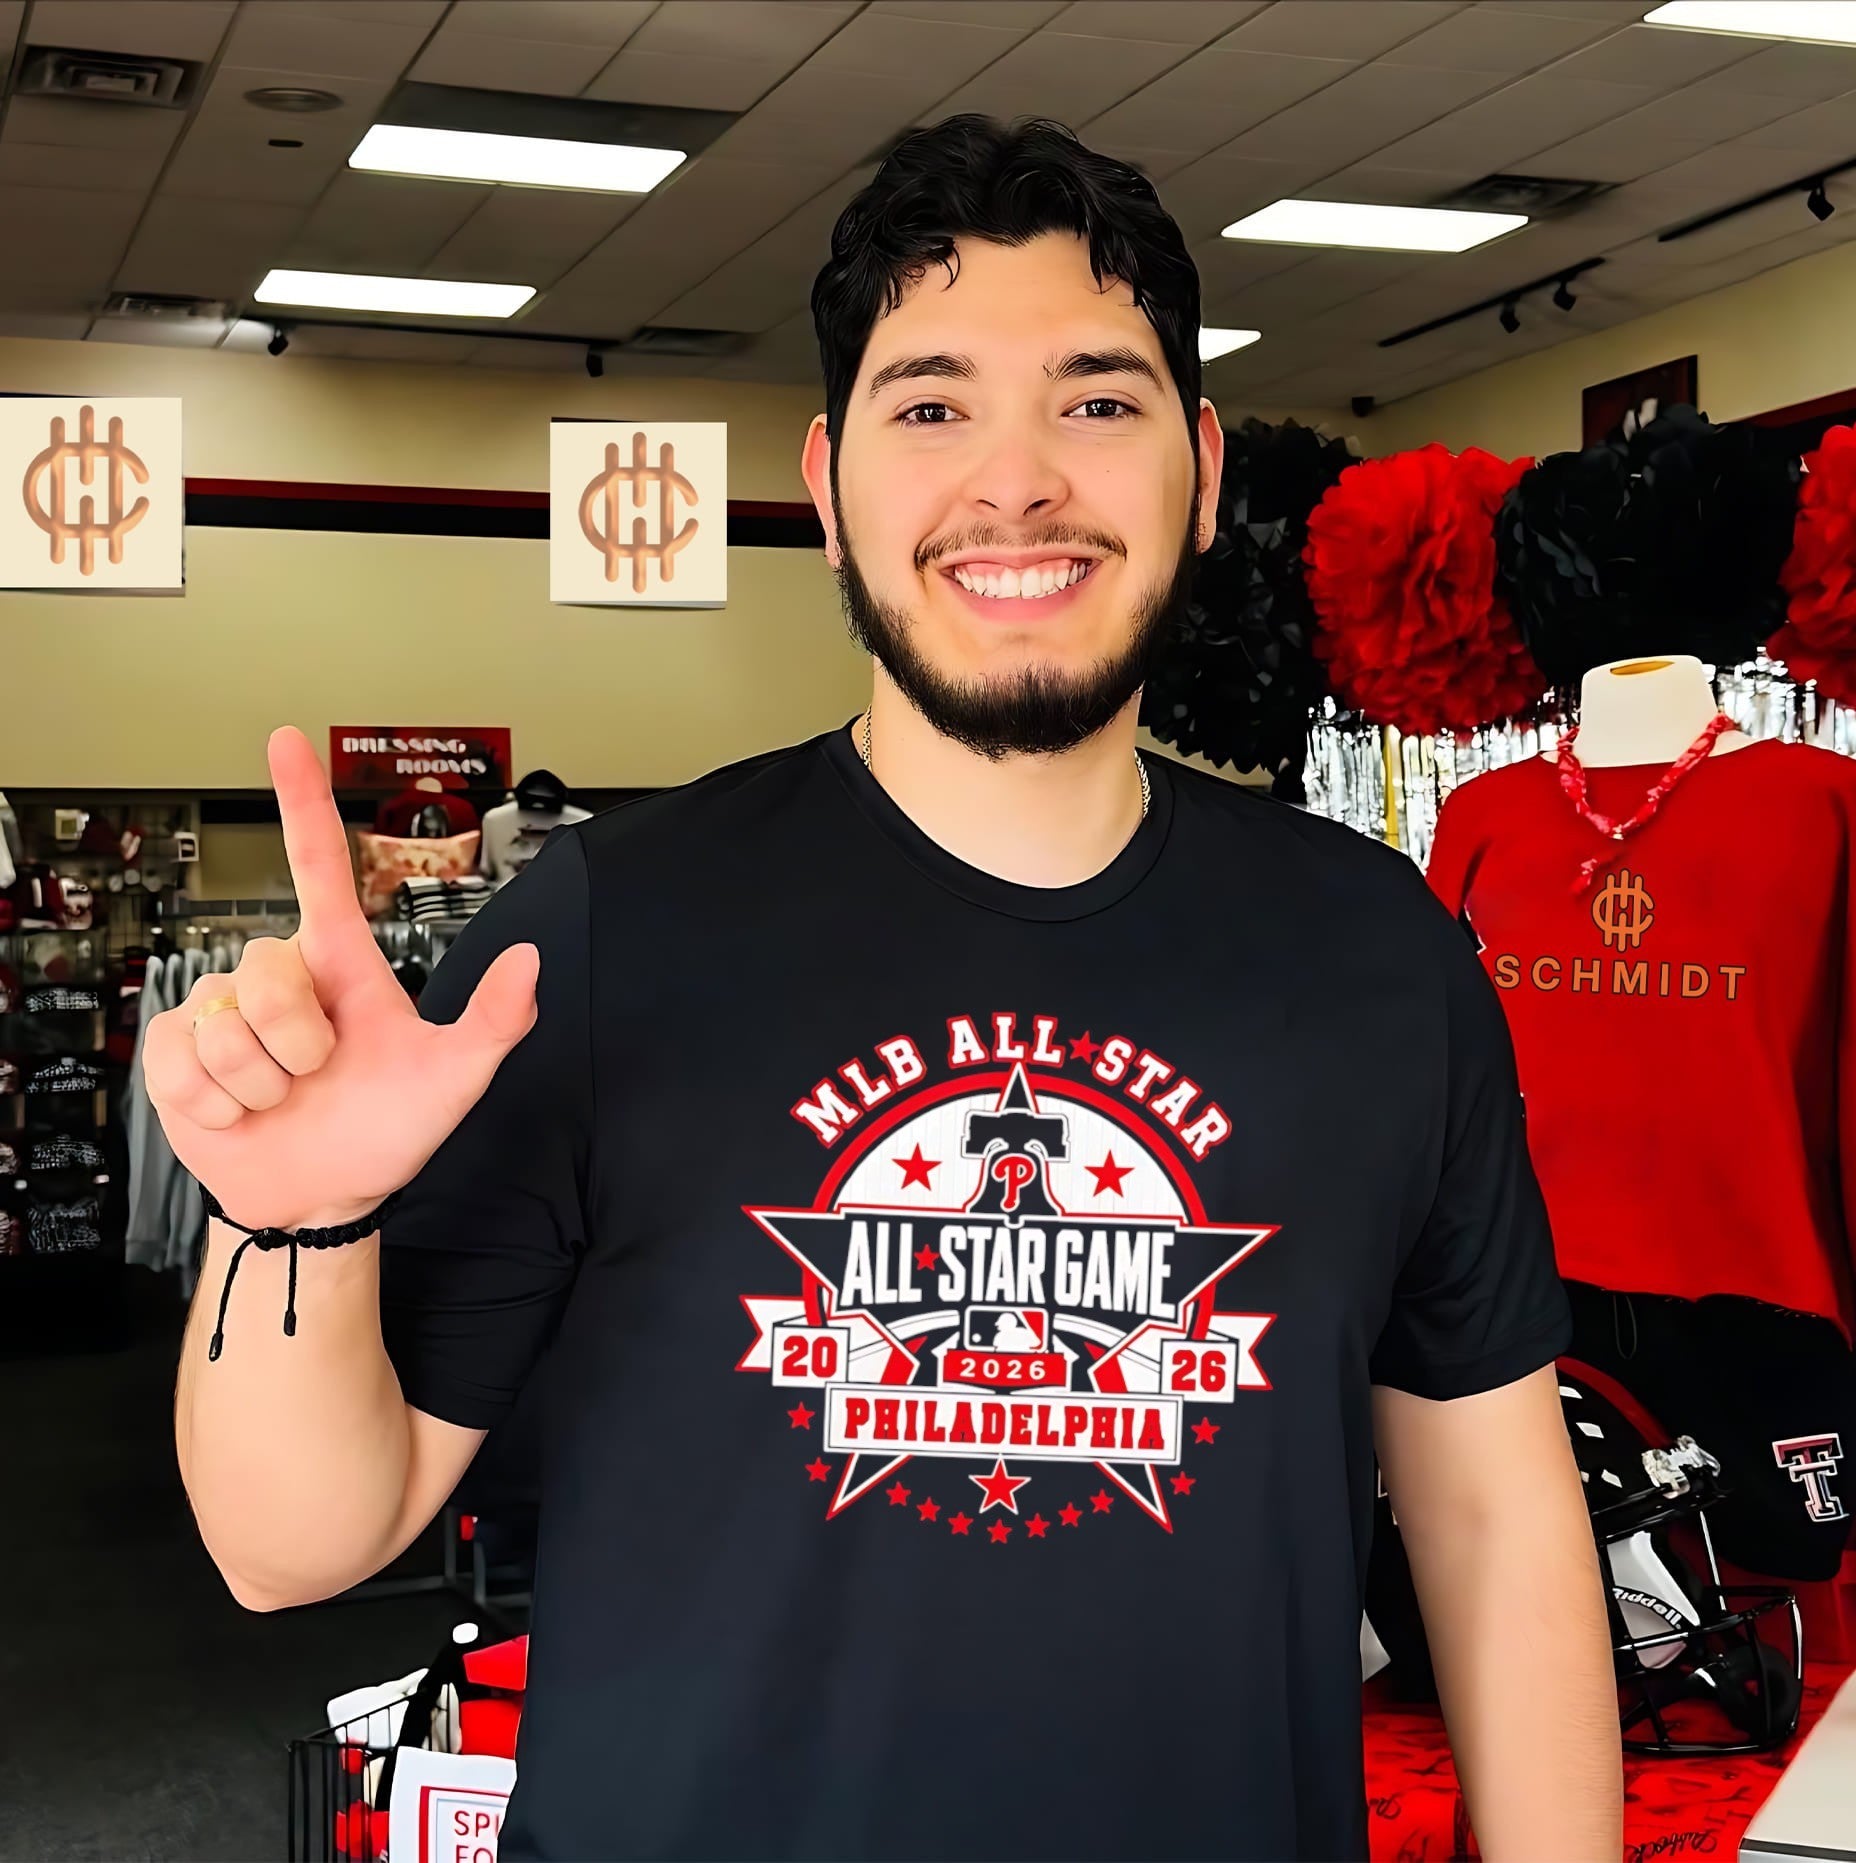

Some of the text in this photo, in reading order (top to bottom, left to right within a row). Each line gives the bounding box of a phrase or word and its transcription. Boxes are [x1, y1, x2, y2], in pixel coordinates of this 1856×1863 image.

[342, 737, 466, 753] DRESSING
[396, 758, 486, 774] ROOMS
[1494, 953, 1747, 1001] SCHMIDT
[790, 1034, 927, 1148] MLB
[993, 1152, 1035, 1213] P
[1054, 1229, 1176, 1319] GAME
[782, 1335, 838, 1378] 20
[960, 1357, 1047, 1381] 2026
[1171, 1350, 1227, 1392] 26
[844, 1397, 1166, 1451] PHILADELPHIA
